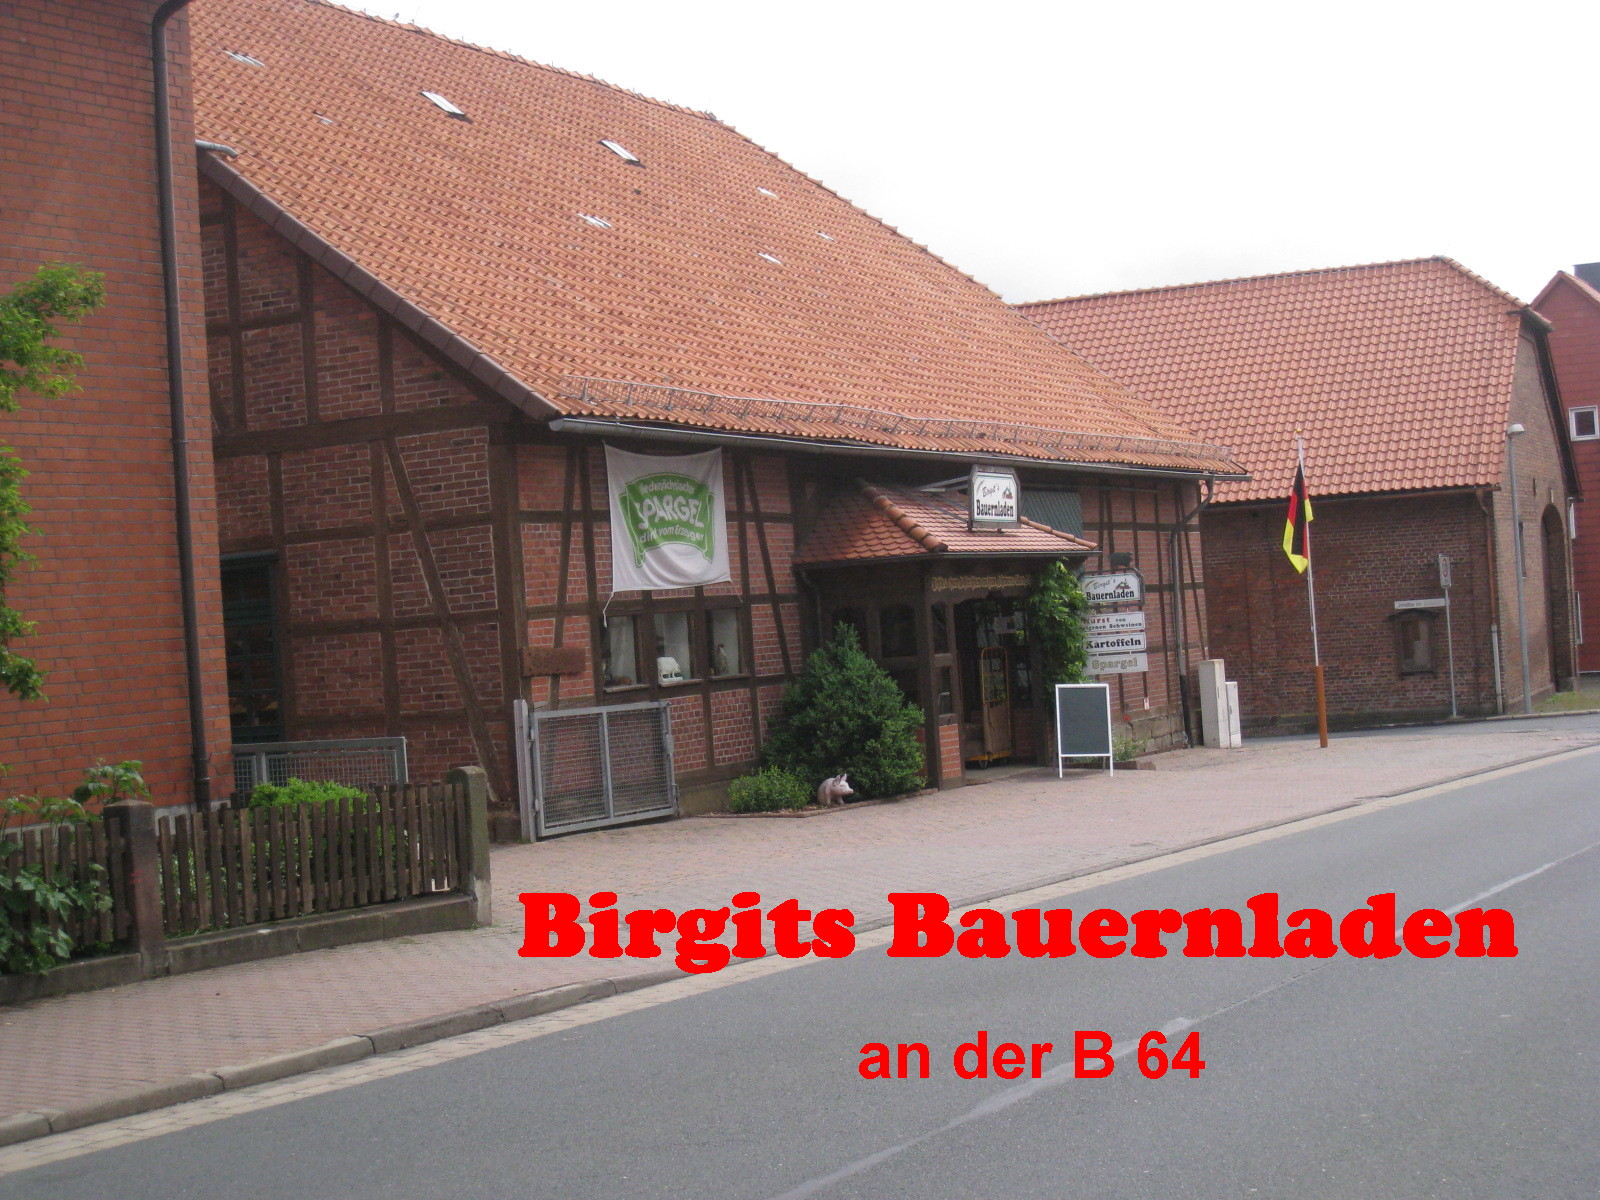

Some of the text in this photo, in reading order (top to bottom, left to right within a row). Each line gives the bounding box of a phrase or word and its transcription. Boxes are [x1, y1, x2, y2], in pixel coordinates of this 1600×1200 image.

[635, 495, 704, 529] SPARGEL
[976, 499, 1014, 517] Bauernladen
[659, 527, 674, 537] vom
[675, 525, 705, 541] Erzeuger
[1085, 589, 1135, 601] Bauernladen
[1085, 638, 1142, 650] Kartoffeln
[1091, 656, 1138, 671] Spargel
